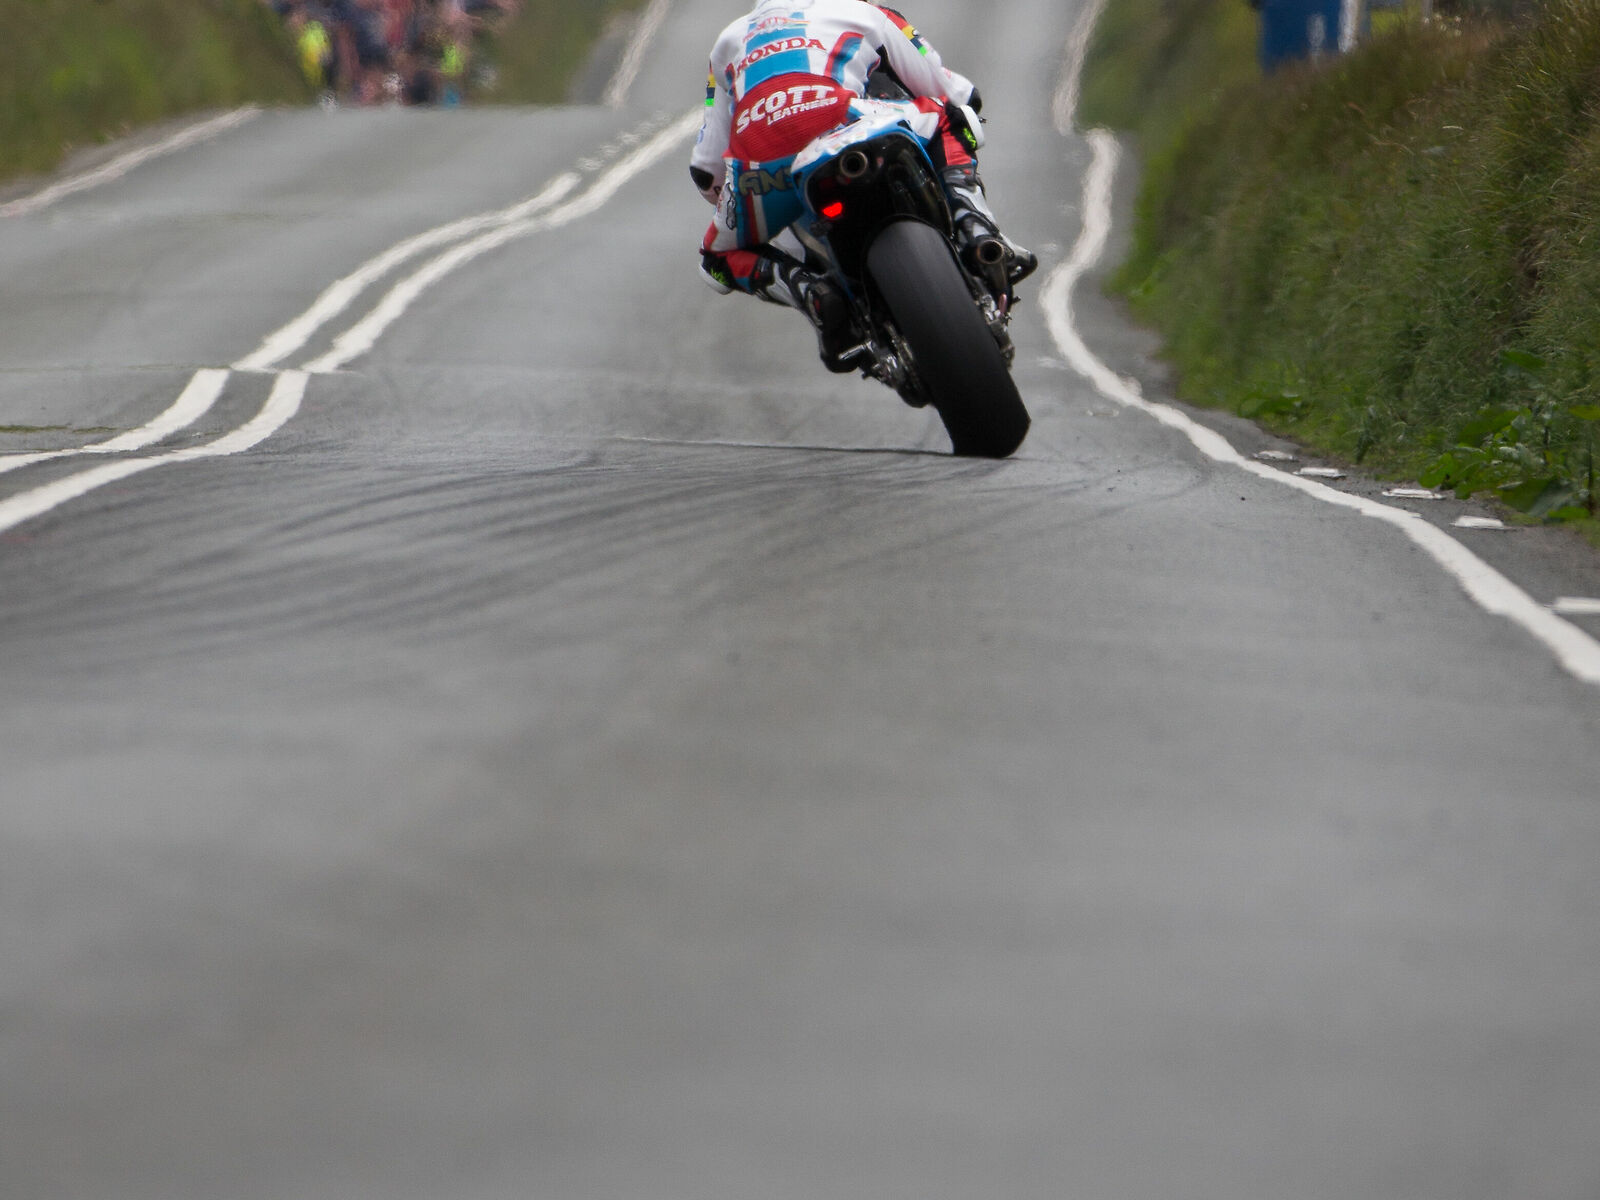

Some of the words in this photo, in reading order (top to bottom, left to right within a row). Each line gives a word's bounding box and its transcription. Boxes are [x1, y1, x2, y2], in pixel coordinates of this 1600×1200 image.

[736, 37, 826, 75] HONDA
[736, 84, 835, 134] SCOTT
[767, 96, 838, 126] LEATHERS
